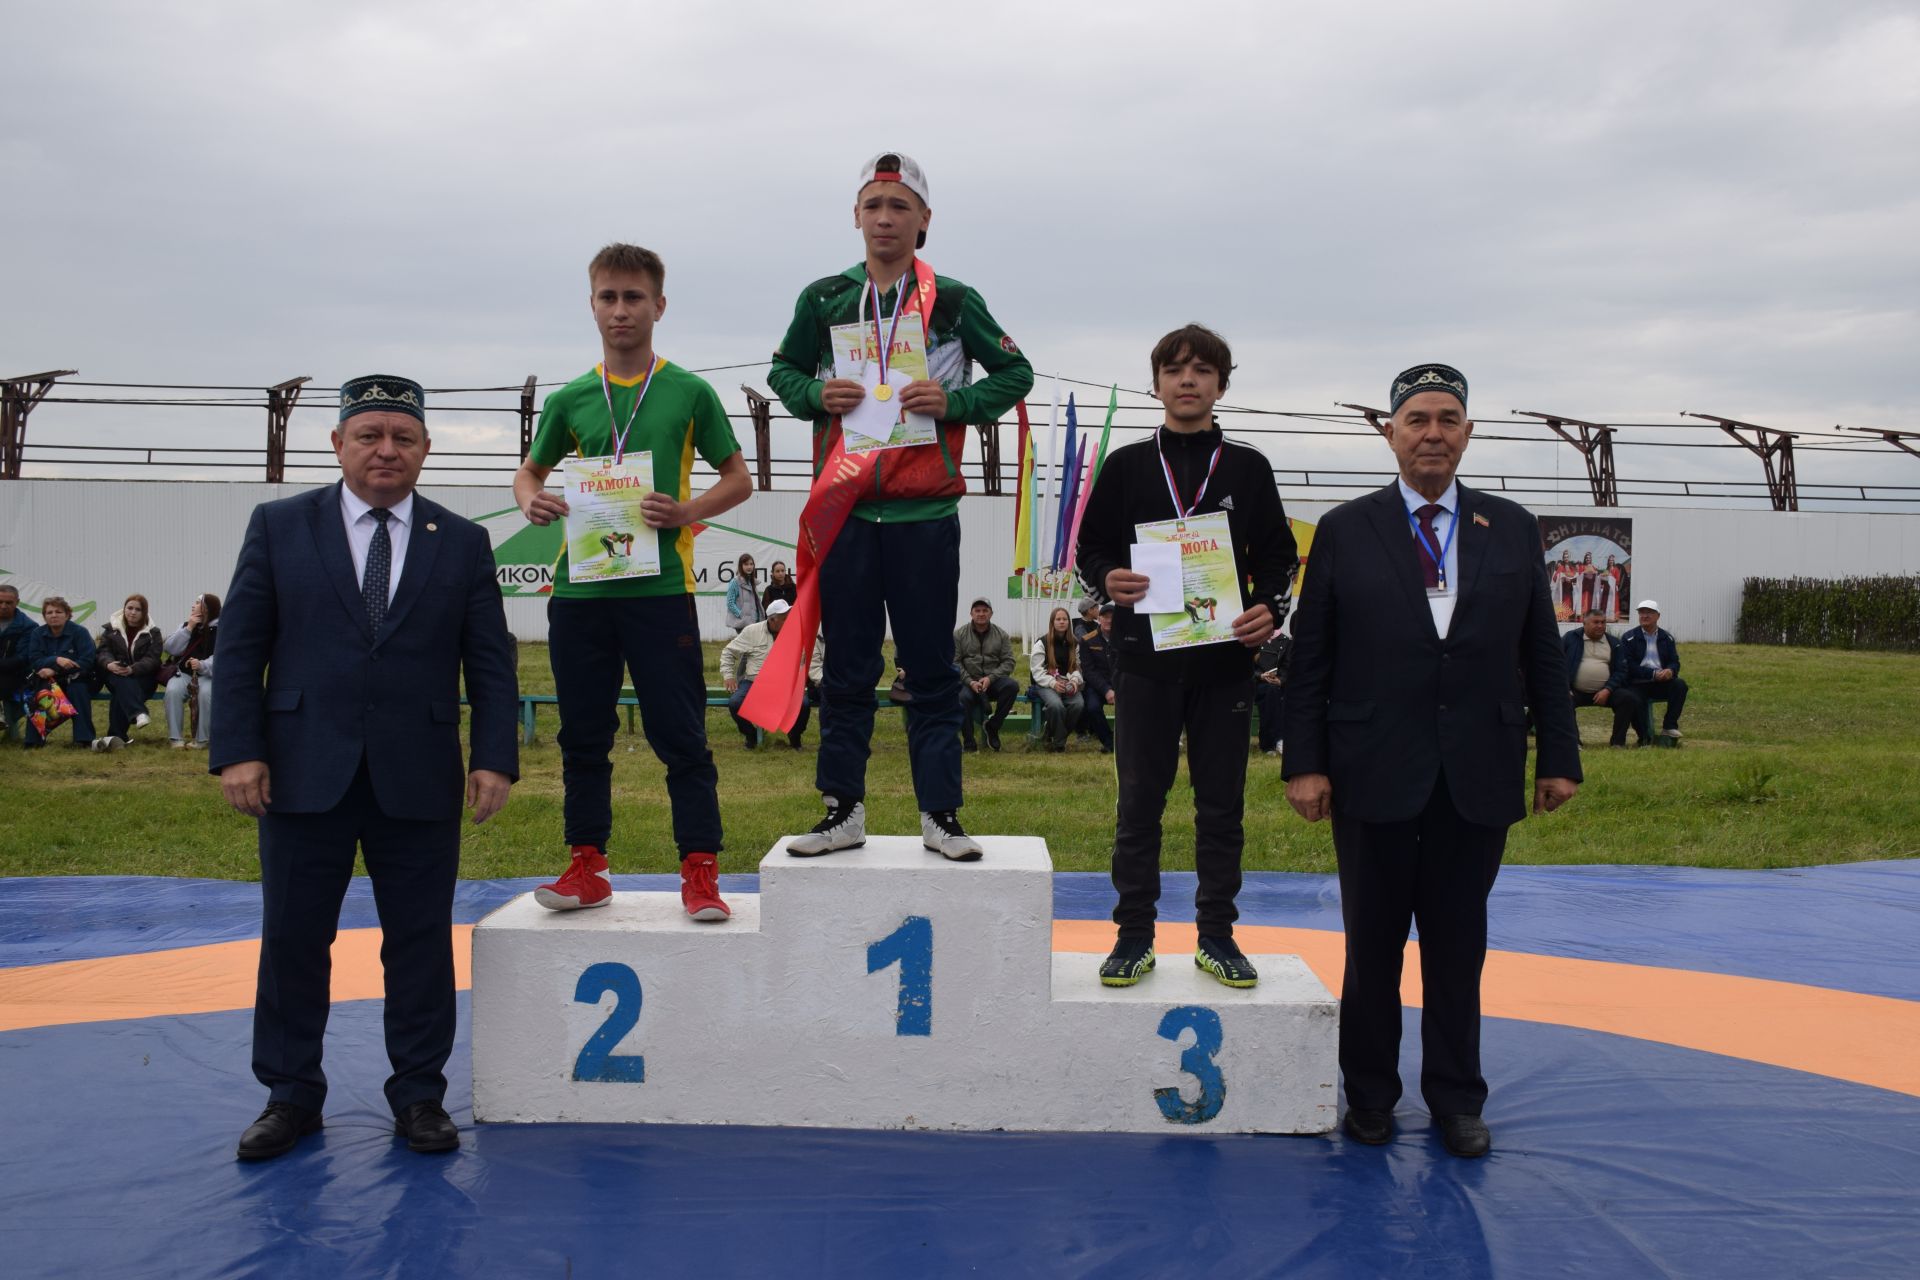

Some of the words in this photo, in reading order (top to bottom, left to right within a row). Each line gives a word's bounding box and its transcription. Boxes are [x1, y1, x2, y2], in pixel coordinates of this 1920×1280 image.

[580, 476, 640, 493] ГРАМОТА
[1181, 538, 1219, 555] МОТА
[1558, 521, 1622, 539] НУРЛАТ
[866, 915, 933, 1036] 1
[572, 962, 645, 1083] 2
[1153, 1005, 1226, 1125] 3
